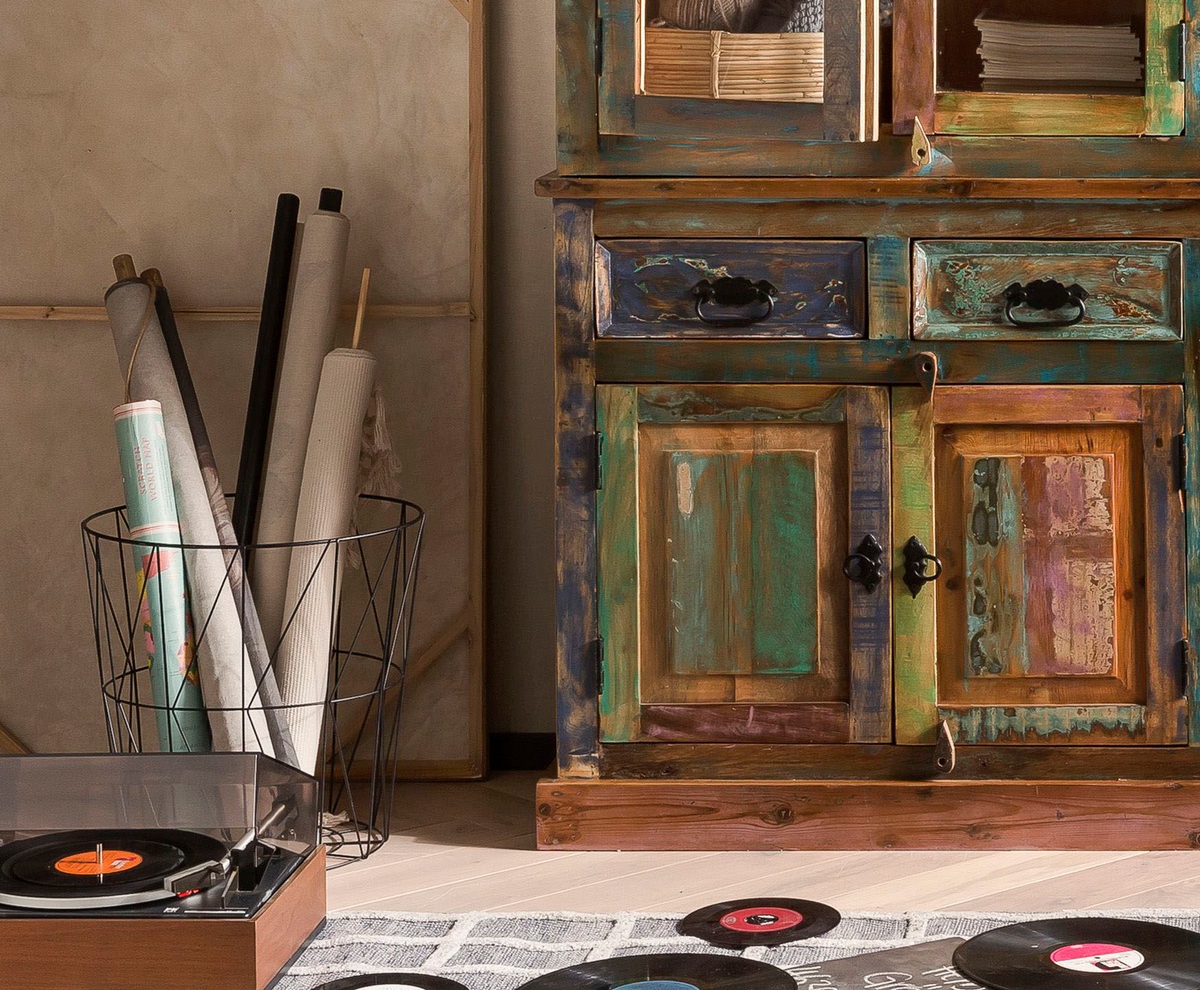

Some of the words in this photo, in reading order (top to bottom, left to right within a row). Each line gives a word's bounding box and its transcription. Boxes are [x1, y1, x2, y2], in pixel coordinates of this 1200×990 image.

[142, 437, 151, 458] MAP
[134, 446, 147, 495] SCRATCH
[145, 463, 158, 501] WORLD
